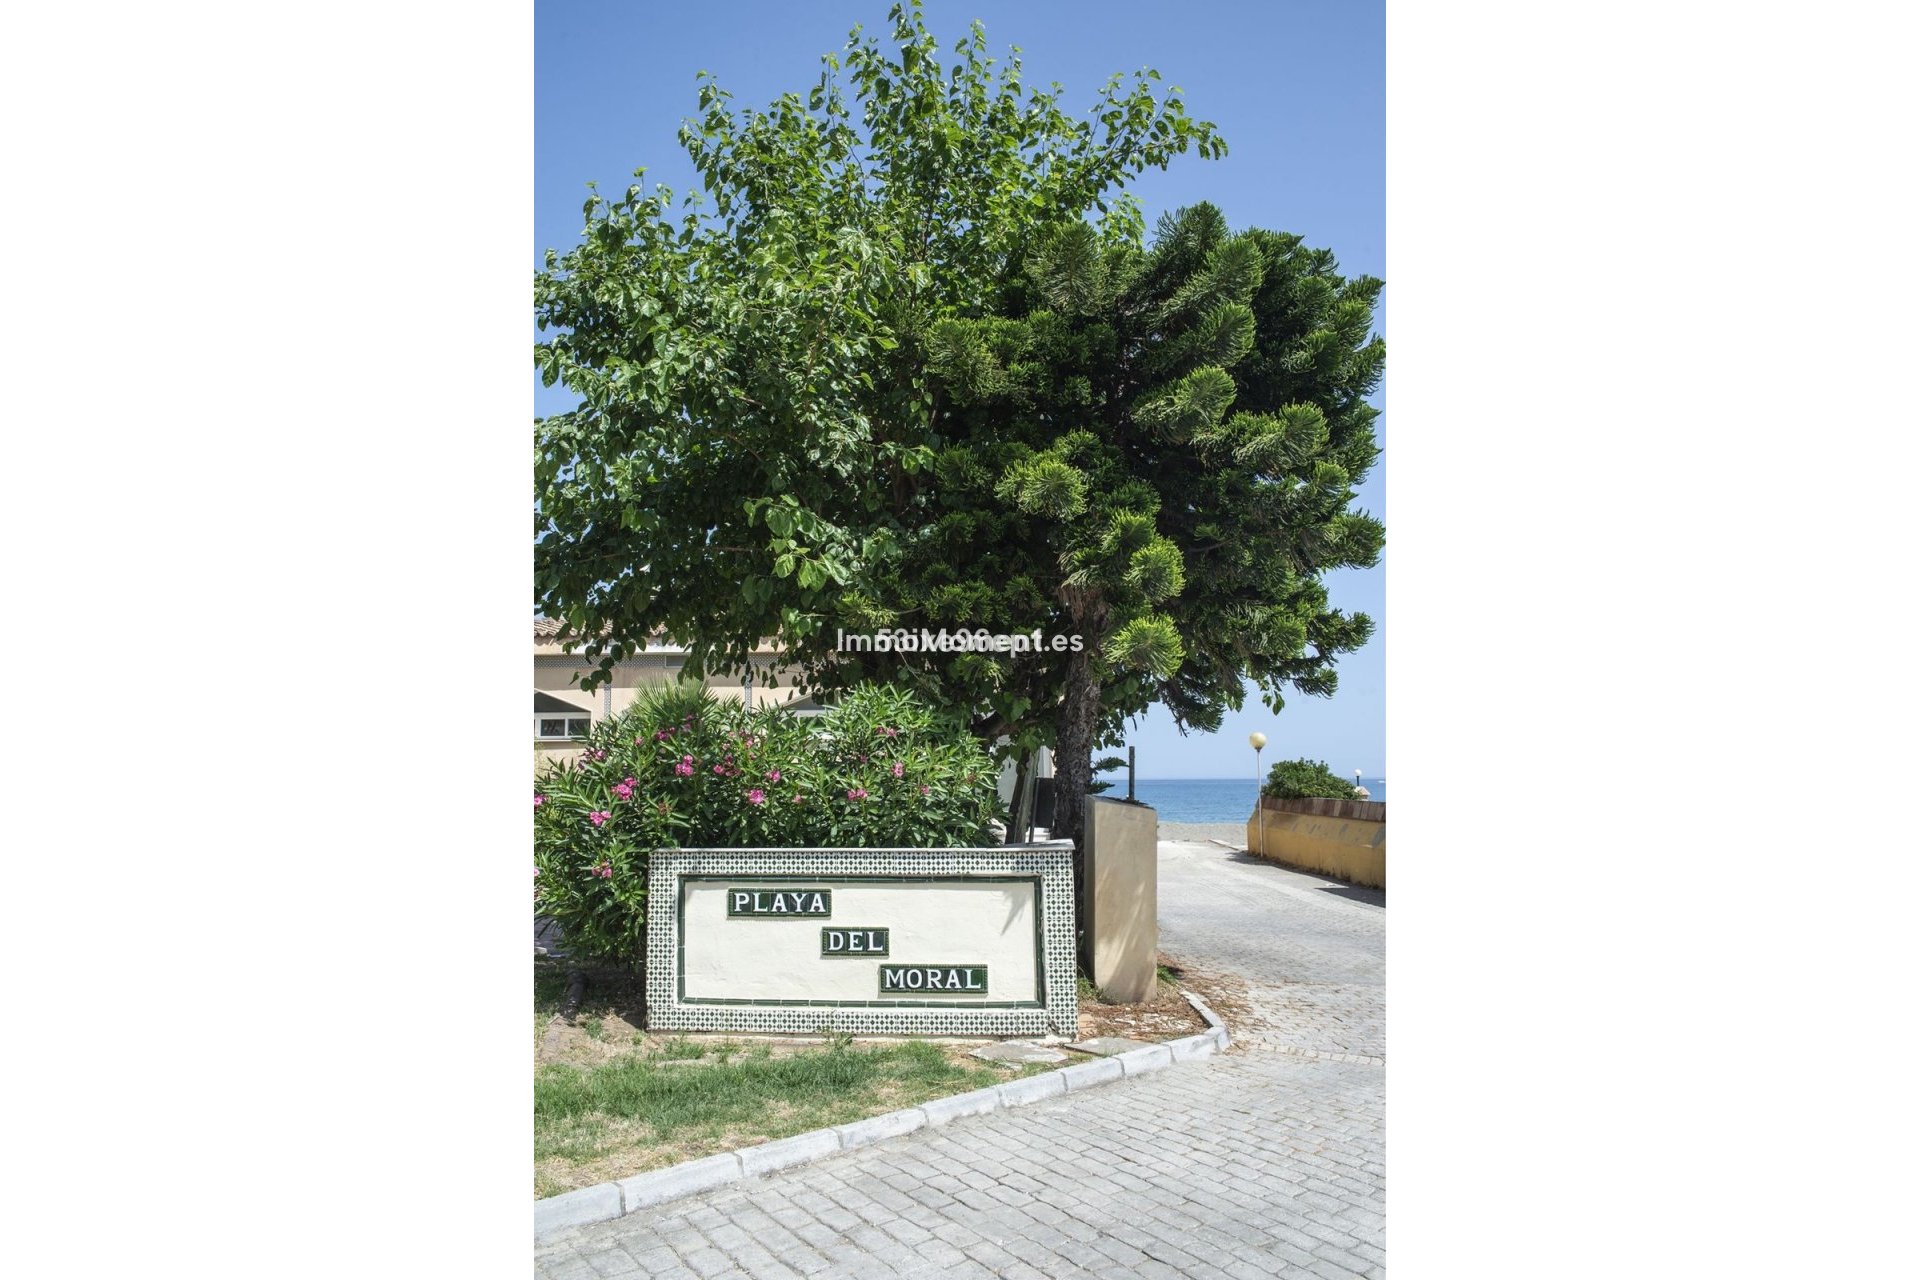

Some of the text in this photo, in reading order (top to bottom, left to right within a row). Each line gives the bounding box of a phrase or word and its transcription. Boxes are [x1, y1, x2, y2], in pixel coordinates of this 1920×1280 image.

[734, 892, 826, 913] PLAYA
[828, 931, 883, 952] DEL
[885, 968, 981, 989] MORAL
